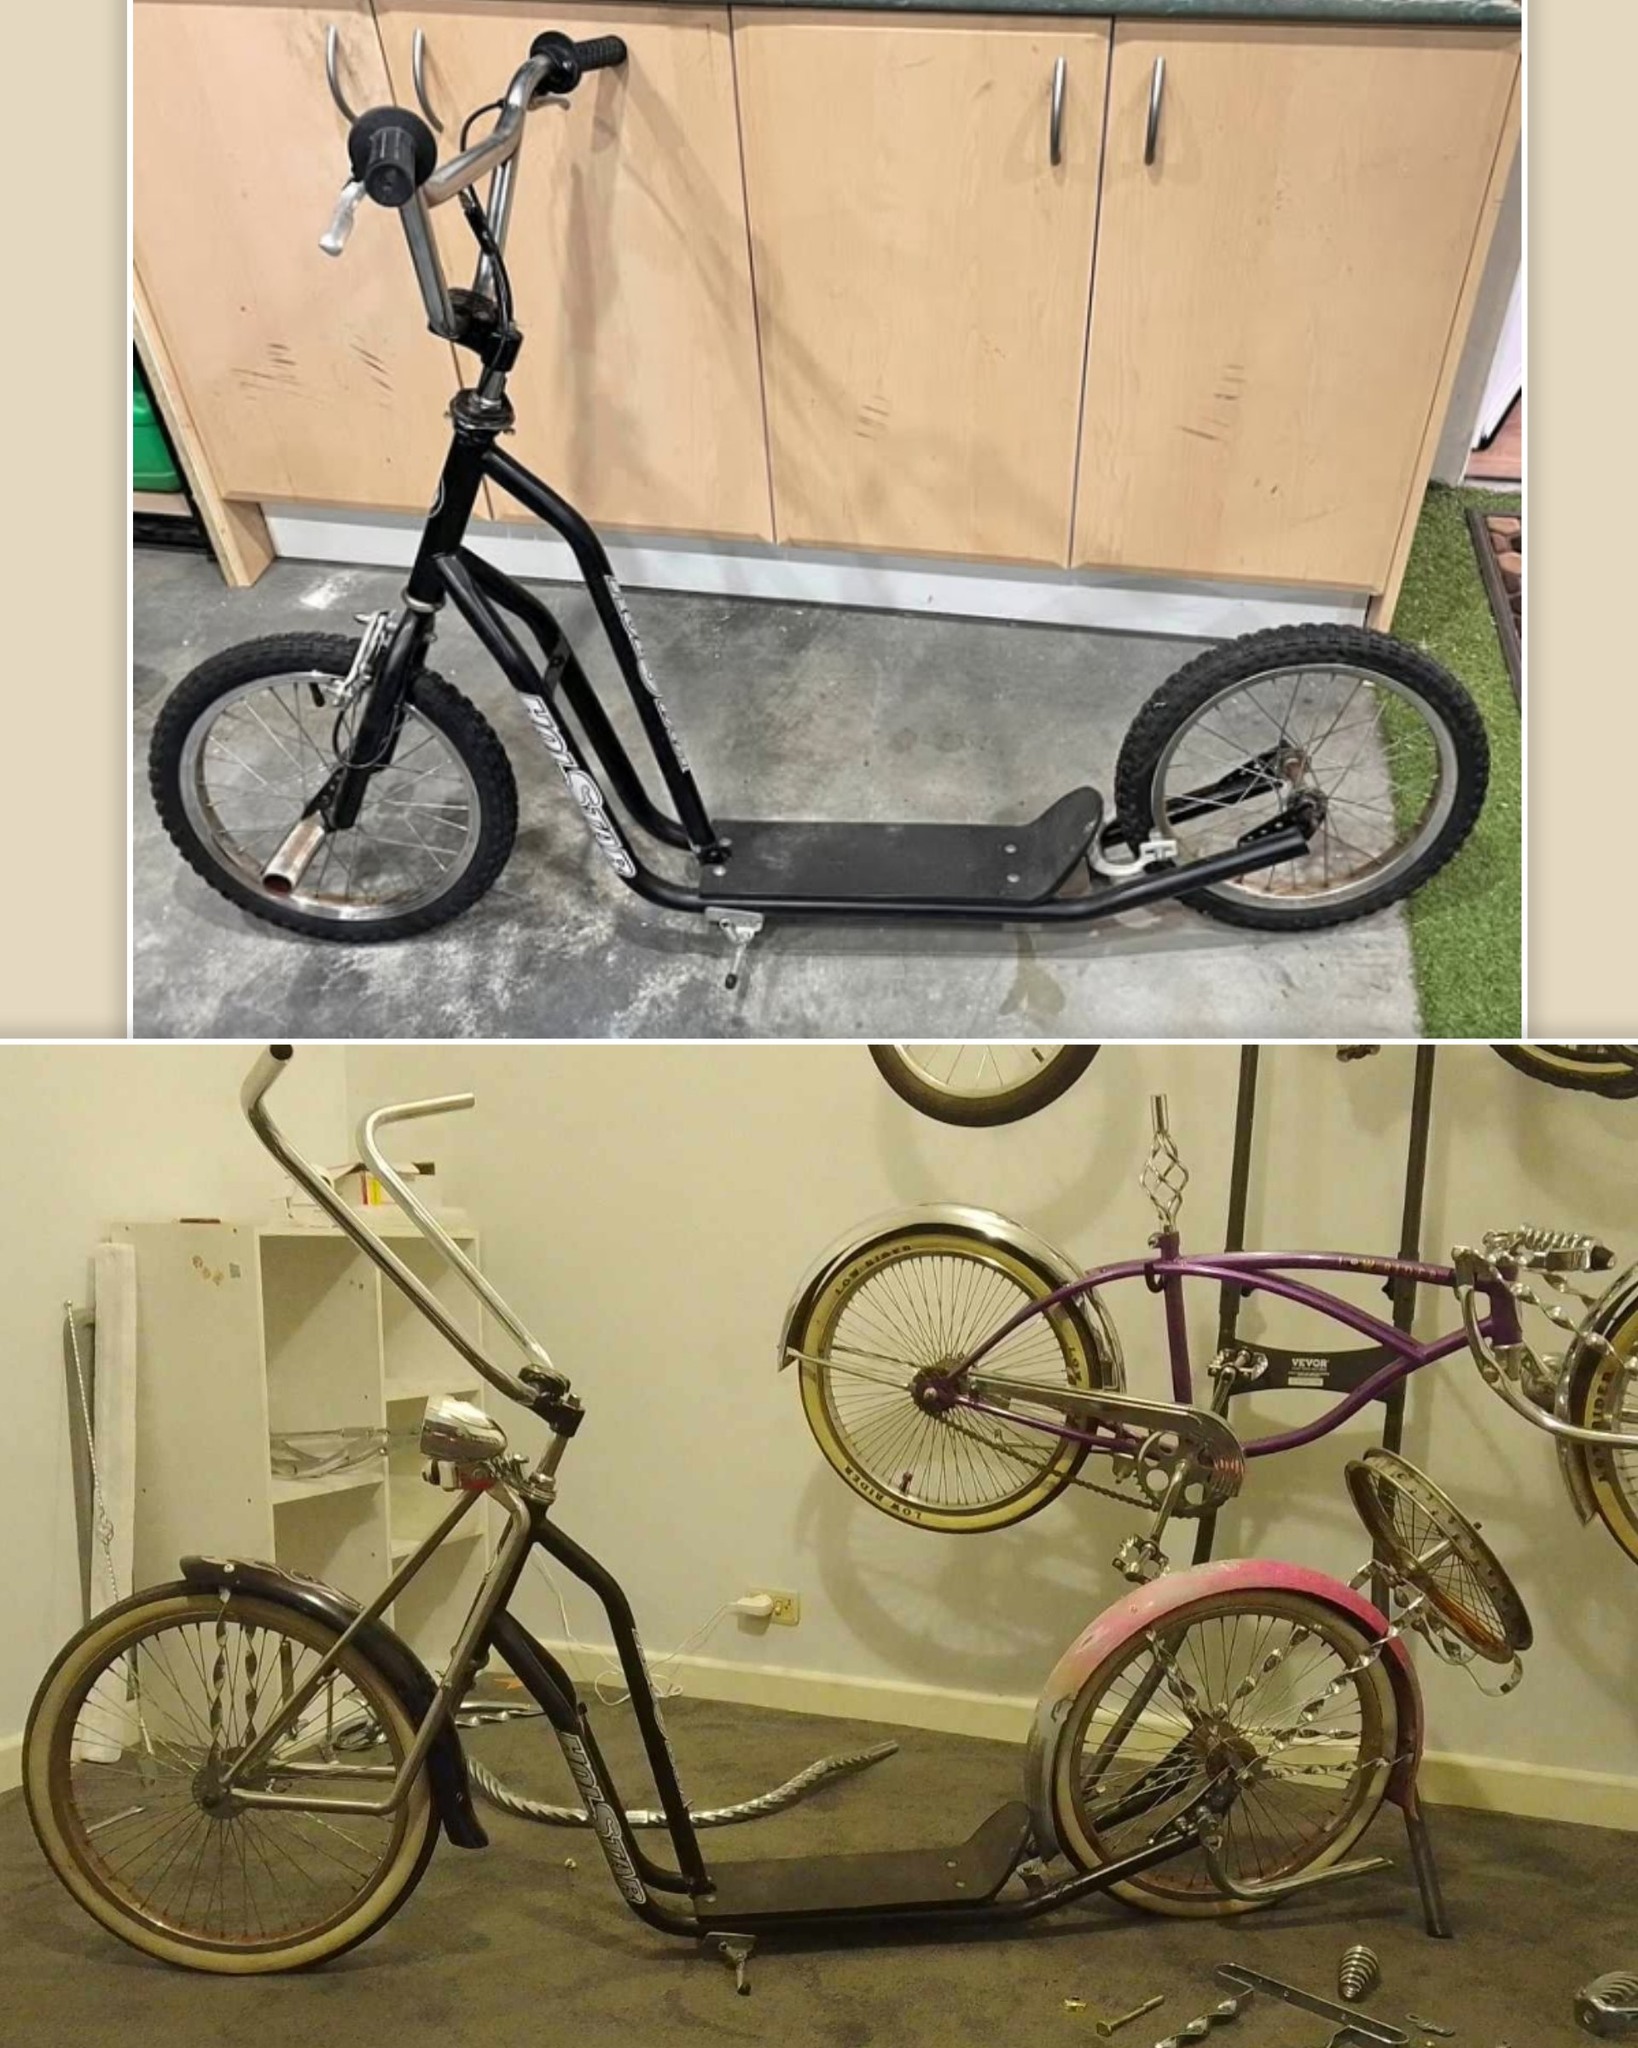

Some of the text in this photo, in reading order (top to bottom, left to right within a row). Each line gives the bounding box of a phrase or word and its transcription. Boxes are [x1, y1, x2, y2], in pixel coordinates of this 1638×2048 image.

[835, 1268, 860, 1295] LOW
[1291, 1358, 1328, 1367] VEVOR
[845, 1465, 922, 1519] LOW RIDER
[558, 1732, 646, 1904] HOLSTAR
